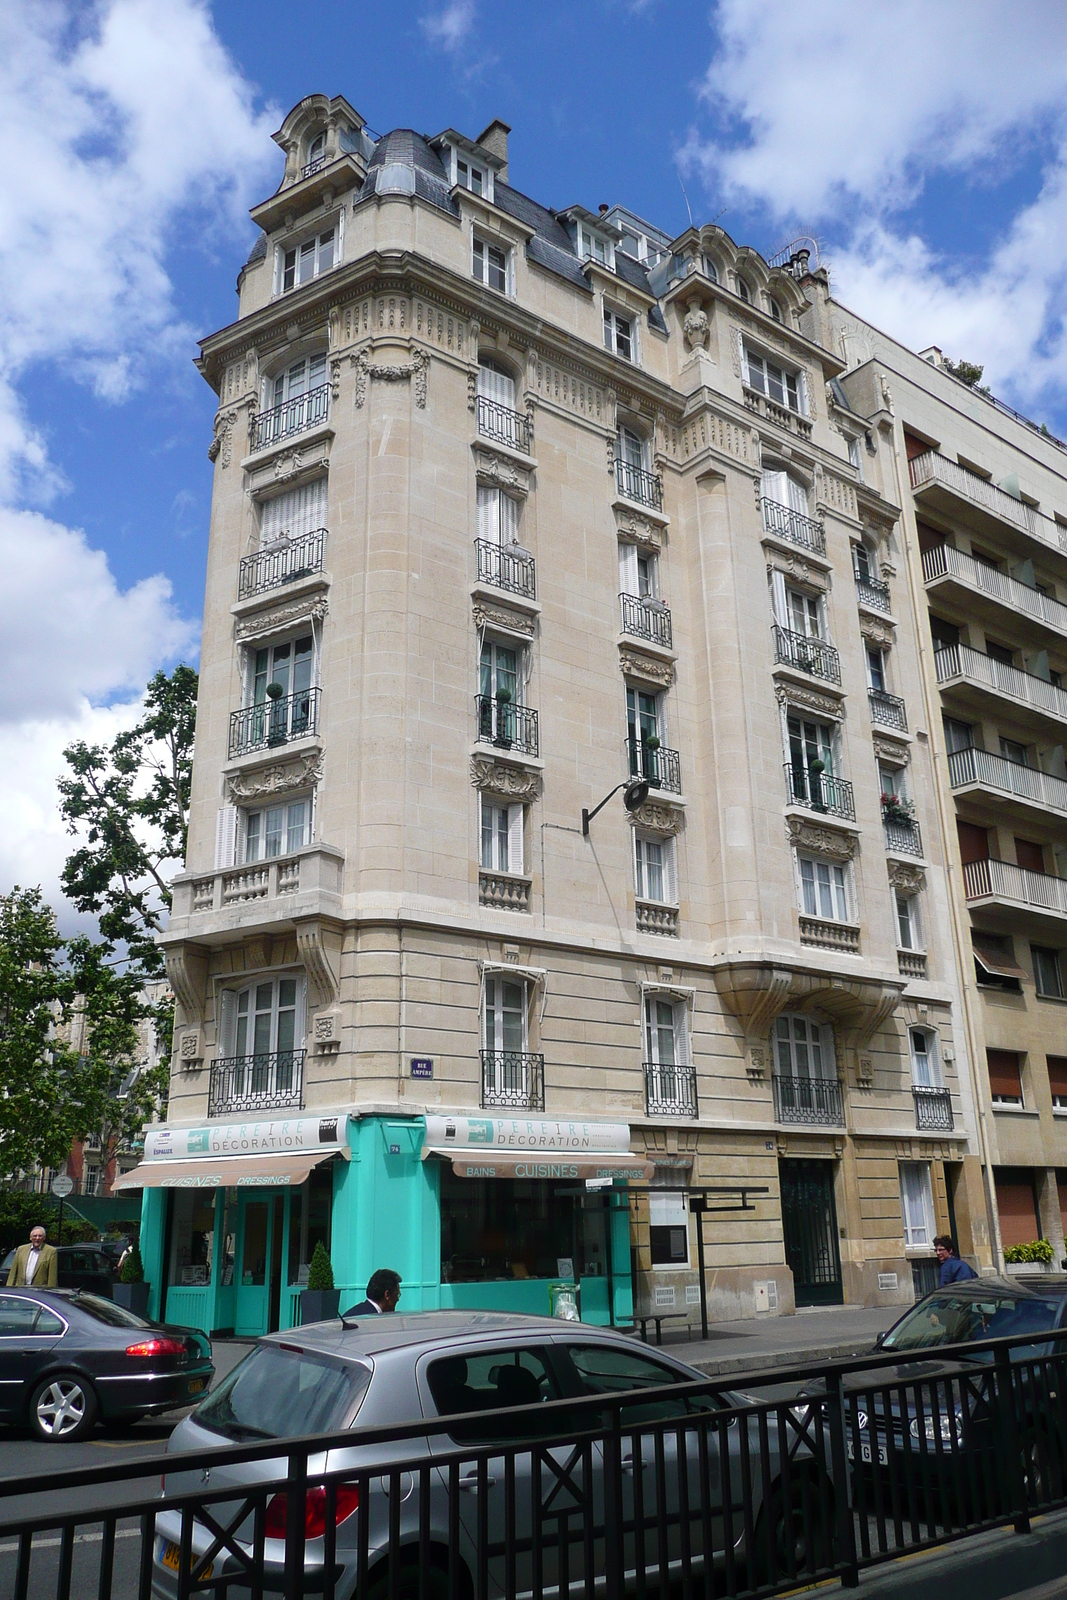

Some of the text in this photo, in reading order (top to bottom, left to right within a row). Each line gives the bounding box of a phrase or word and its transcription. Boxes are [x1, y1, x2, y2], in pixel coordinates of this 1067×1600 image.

[213, 1121, 304, 1139] PEREIRE
[320, 1119, 338, 1127] hardy
[497, 1121, 590, 1137] PEREIRE
[212, 1136, 304, 1151] DÉCORATION
[497, 1133, 590, 1147] DÉCORATION
[466, 1163, 644, 1179] BAINS CUISINES DRESSINGS
[160, 1175, 222, 1187] CUISINES
[236, 1175, 291, 1185] DRESSINGS
